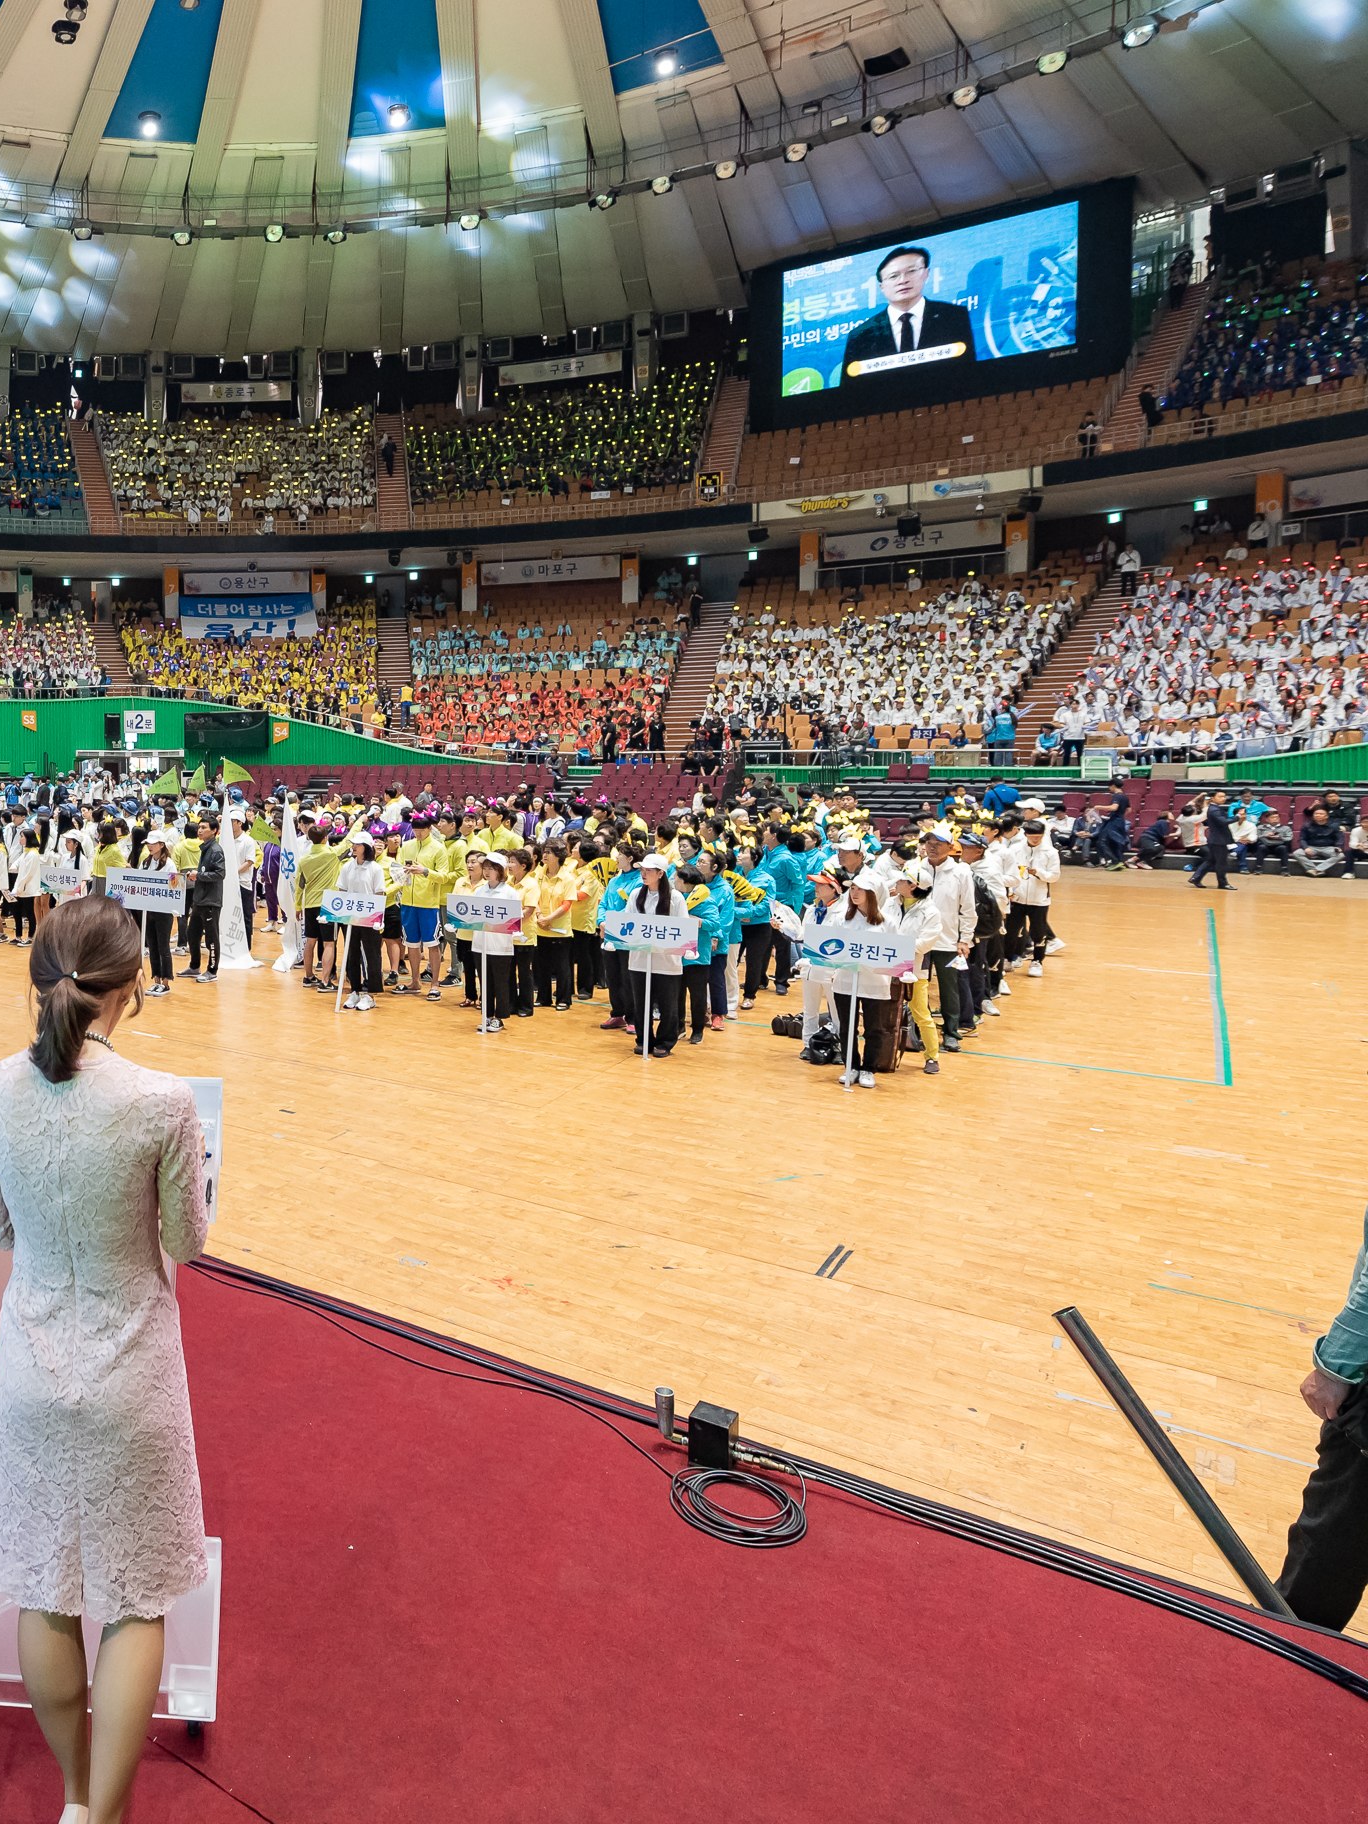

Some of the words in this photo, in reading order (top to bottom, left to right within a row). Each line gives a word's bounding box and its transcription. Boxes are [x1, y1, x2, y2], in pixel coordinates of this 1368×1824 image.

[549, 361, 585, 376] 구로구
[224, 386, 256, 399] 종로구
[1257, 499, 1281, 513] 10
[538, 562, 578, 577] 마포구
[22, 584, 30, 594] 6
[168, 584, 176, 594] 7
[234, 576, 270, 589] 용산구
[316, 582, 323, 592] 7
[197, 598, 243, 616] 더불어
[247, 600, 295, 616] 잘사는
[23, 714, 35, 725] S3
[274, 726, 288, 737] S4
[912, 729, 932, 739] 광진
[59, 874, 78, 886] 성북구
[345, 900, 374, 913] 강동구
[470, 904, 508, 920] 노원구
[640, 924, 682, 941] 강남구
[848, 942, 898, 963] 광진구
